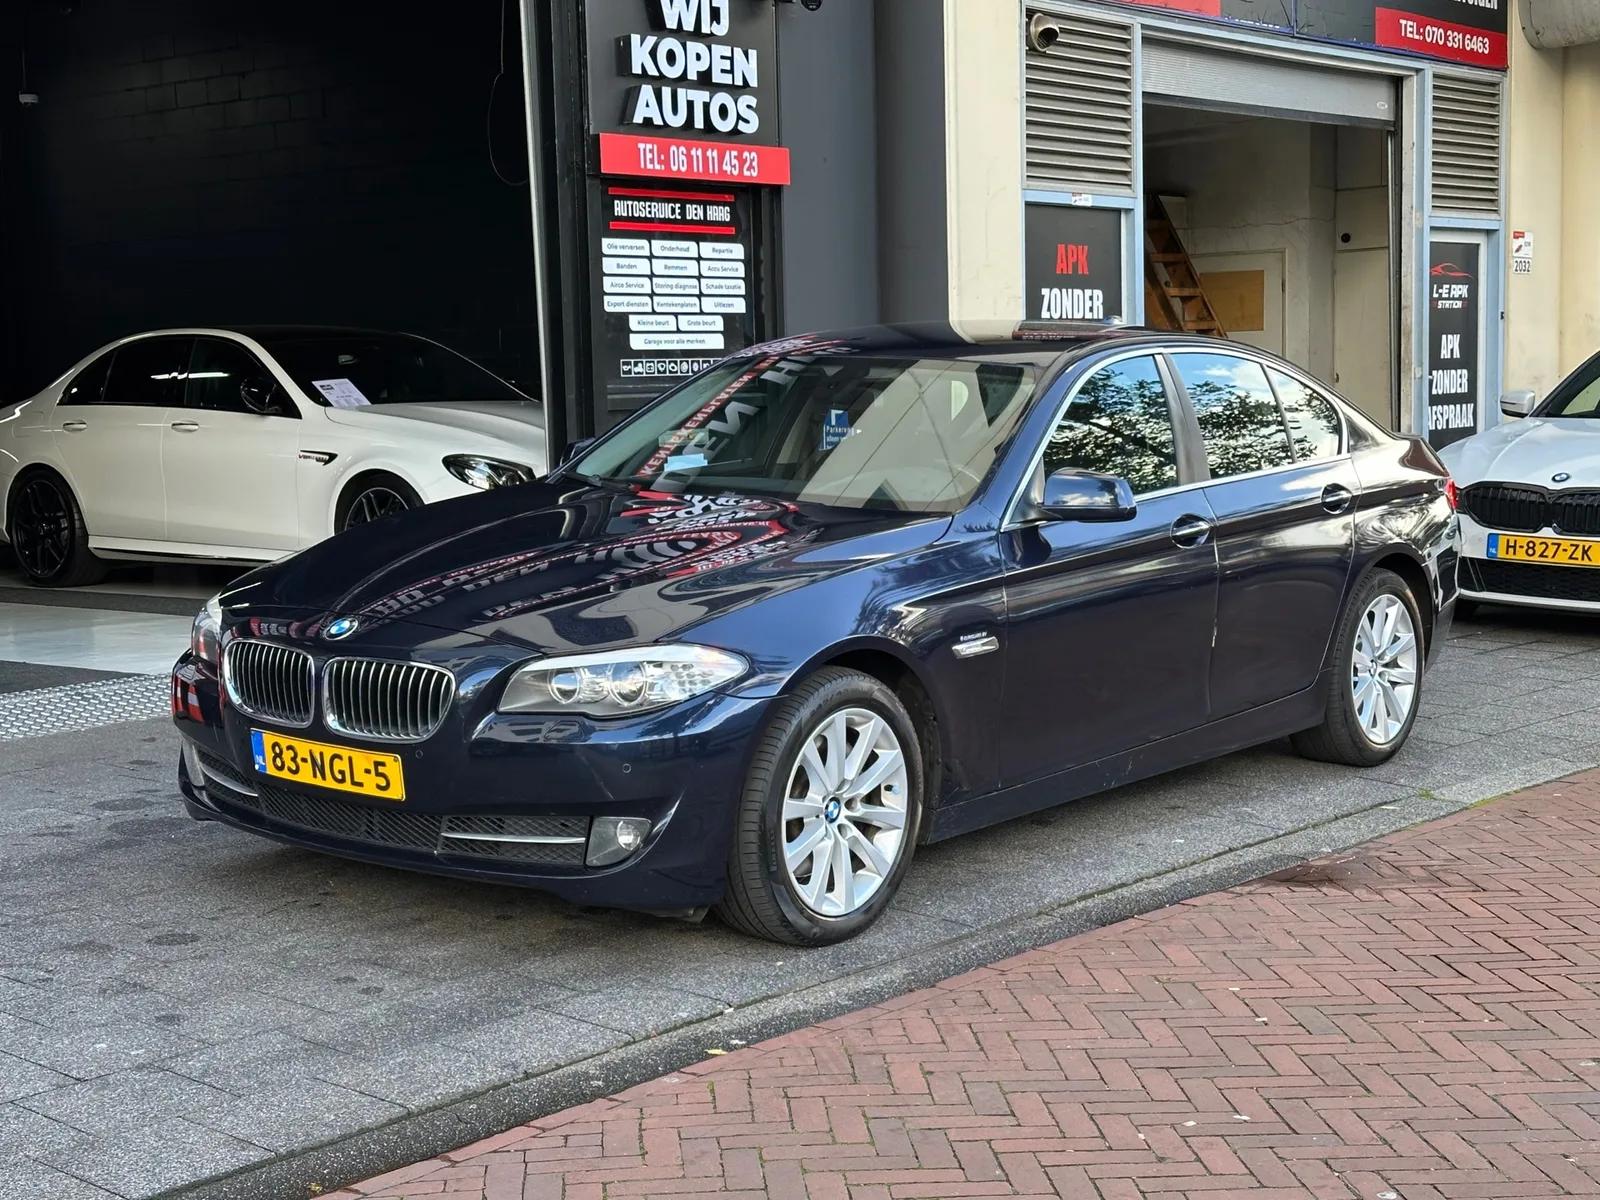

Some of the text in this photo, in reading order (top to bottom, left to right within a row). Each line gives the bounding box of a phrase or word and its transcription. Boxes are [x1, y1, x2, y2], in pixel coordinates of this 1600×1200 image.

[661, 0, 730, 36] WIJ
[1399, 19, 1490, 54] TEL: 070 331 6463
[630, 34, 758, 87] KOPEN
[632, 84, 760, 134] AUTOS
[637, 142, 759, 177] TEL: 06 11 11 45 23
[614, 199, 731, 222] AUTOSERVICE DEN HAAG
[660, 245, 690, 253] Onderhoud
[1056, 244, 1089, 275] APK
[1514, 260, 1531, 273] 2032
[655, 282, 674, 290] Storing
[1450, 284, 1469, 298] APK
[1041, 287, 1103, 320] ZONDER
[1437, 300, 1463, 309] STATION
[1440, 333, 1460, 359] APK
[1431, 369, 1468, 395] ZONDER
[1505, 538, 1593, 562] H-827-ZK
[255, 740, 391, 792] NL 83-NGL-5
